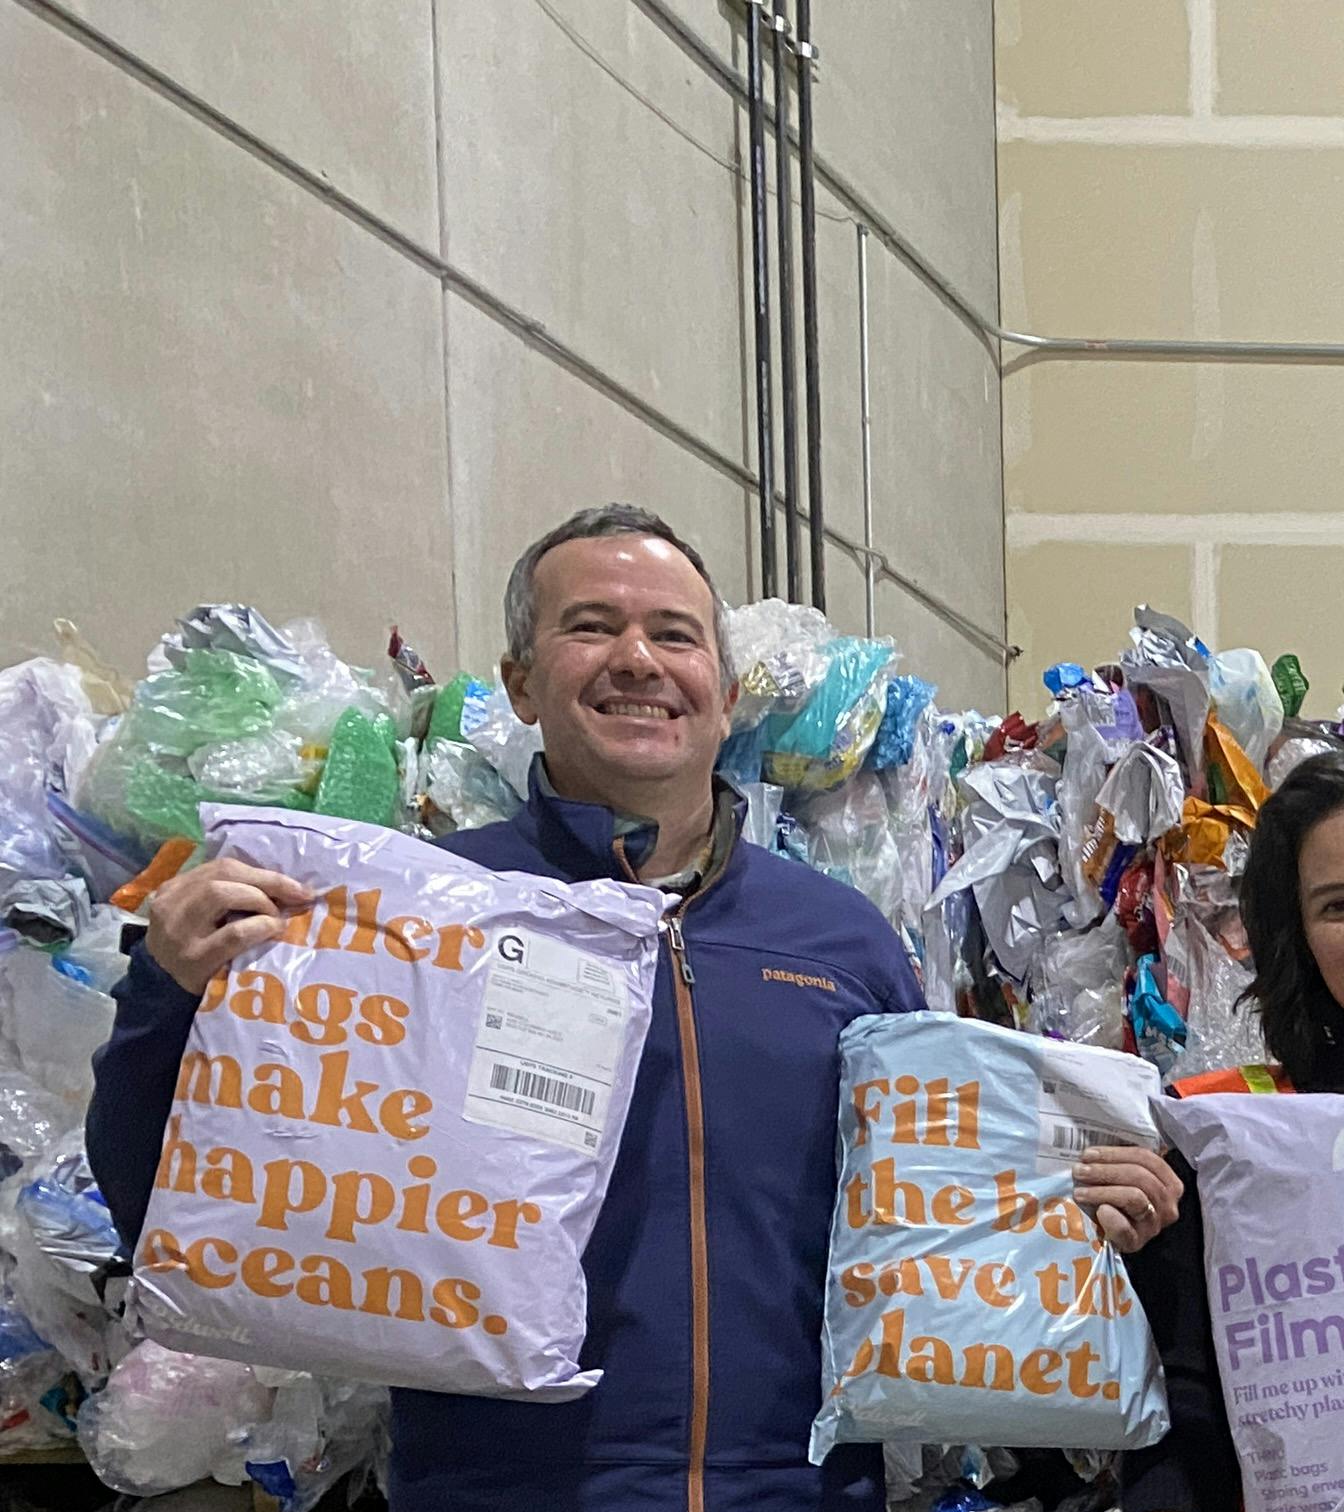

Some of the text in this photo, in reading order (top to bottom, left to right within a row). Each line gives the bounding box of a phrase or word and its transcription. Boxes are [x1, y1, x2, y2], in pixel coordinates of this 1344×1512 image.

[498, 935, 524, 964] G
[761, 968, 837, 992] patagonia
[175, 1049, 434, 1141] make
[851, 1075, 981, 1150] Fill
[156, 1113, 543, 1250] happier
[845, 1157, 1105, 1250] the ba
[142, 1229, 509, 1336] oceans.
[839, 1255, 1132, 1318] save th
[1233, 1386, 1258, 1405] Fill
[1262, 1381, 1289, 1400] me
[1293, 1378, 1318, 1396] up
[1237, 1402, 1309, 1427] stretchy
[1290, 1461, 1328, 1478] bags
